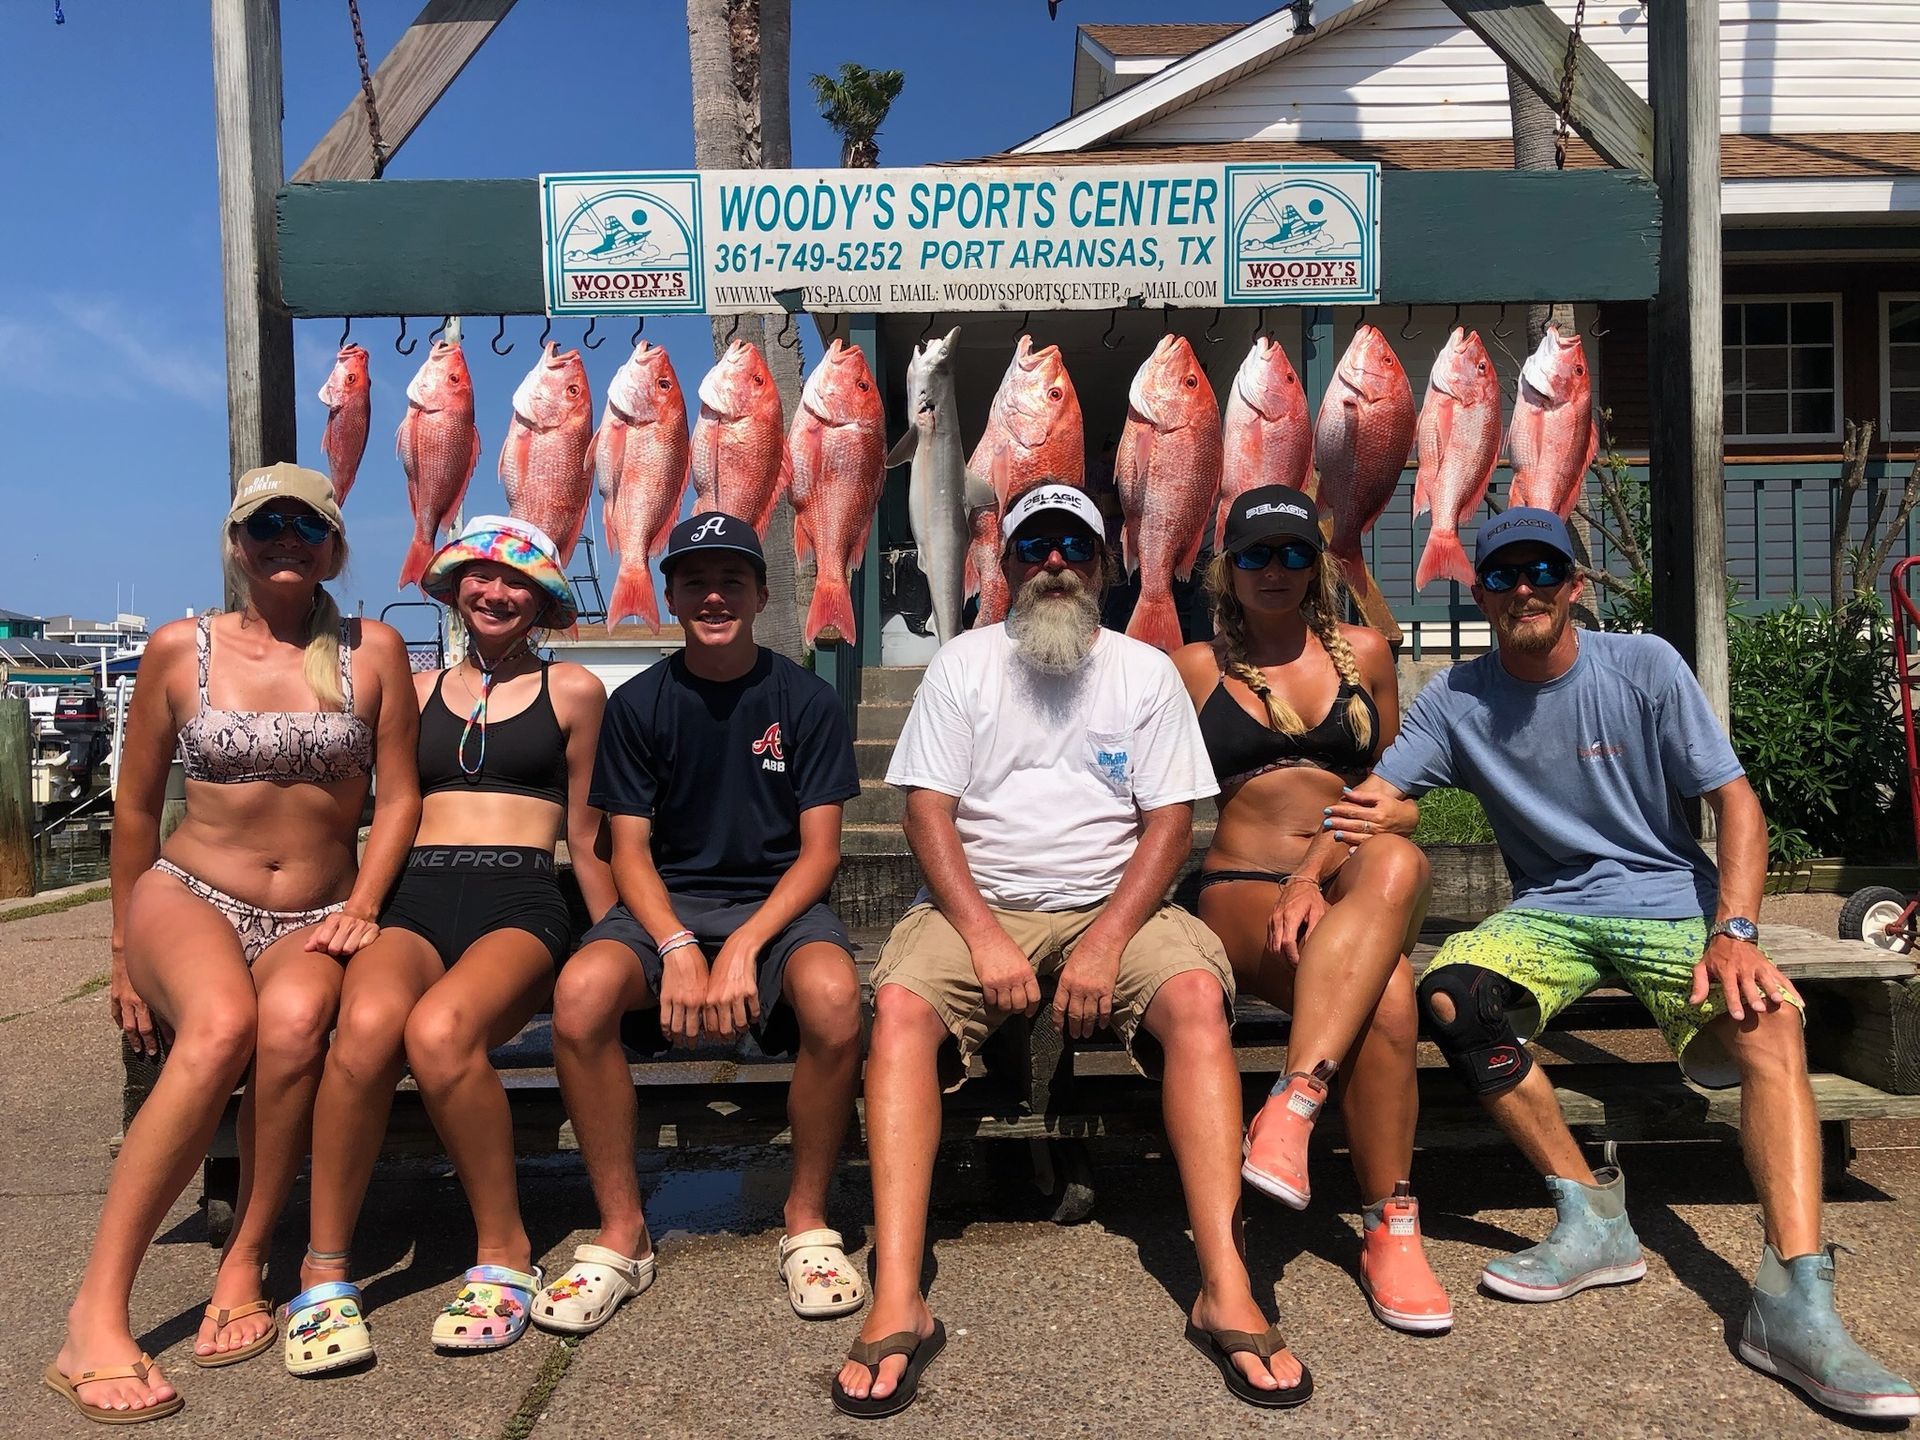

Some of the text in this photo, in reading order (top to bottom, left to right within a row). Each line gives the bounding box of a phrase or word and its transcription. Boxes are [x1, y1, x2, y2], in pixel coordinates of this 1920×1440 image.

[720, 178, 1218, 232] WOODY'S SPORTS CENTER
[714, 236, 1217, 273] 361-749-5252 PORT ARANSAS, TX
[1247, 261, 1356, 279] WOODY'S
[571, 272, 684, 291] WOODY'S
[1246, 276, 1358, 288] SPORTS CENTER
[571, 288, 687, 300] SPORTS CENTER
[715, 285, 882, 303] WWW.WYS-PA.COM
[890, 284, 940, 302] EMAIL:
[1023, 492, 1082, 508] PELAGIC
[1246, 502, 1309, 520] PELAGIC
[690, 516, 727, 542] A
[762, 759, 786, 772] ABB
[451, 850, 523, 868] PRO
